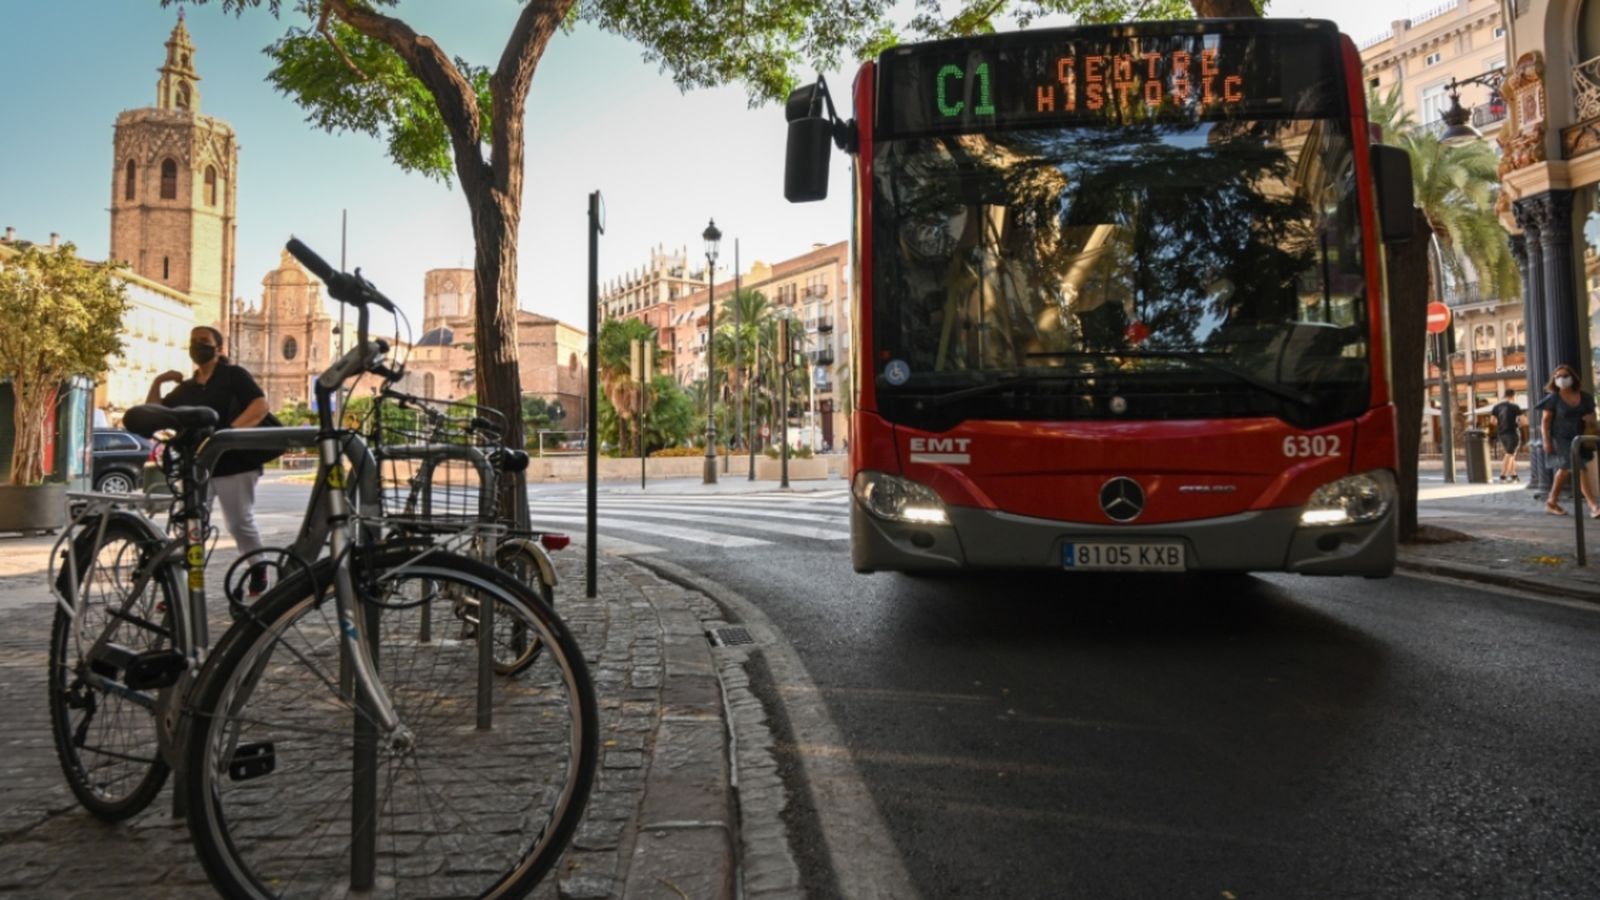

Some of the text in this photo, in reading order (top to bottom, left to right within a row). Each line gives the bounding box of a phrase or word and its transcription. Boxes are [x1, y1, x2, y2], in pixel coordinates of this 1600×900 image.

[1057, 48, 1219, 84] CENTRE
[937, 64, 994, 116] C1
[1037, 75, 1242, 112] HISTORIC
[910, 438, 971, 452] EMT
[1283, 435, 1341, 457] 6302
[1078, 546, 1180, 565] 8105 KXB
